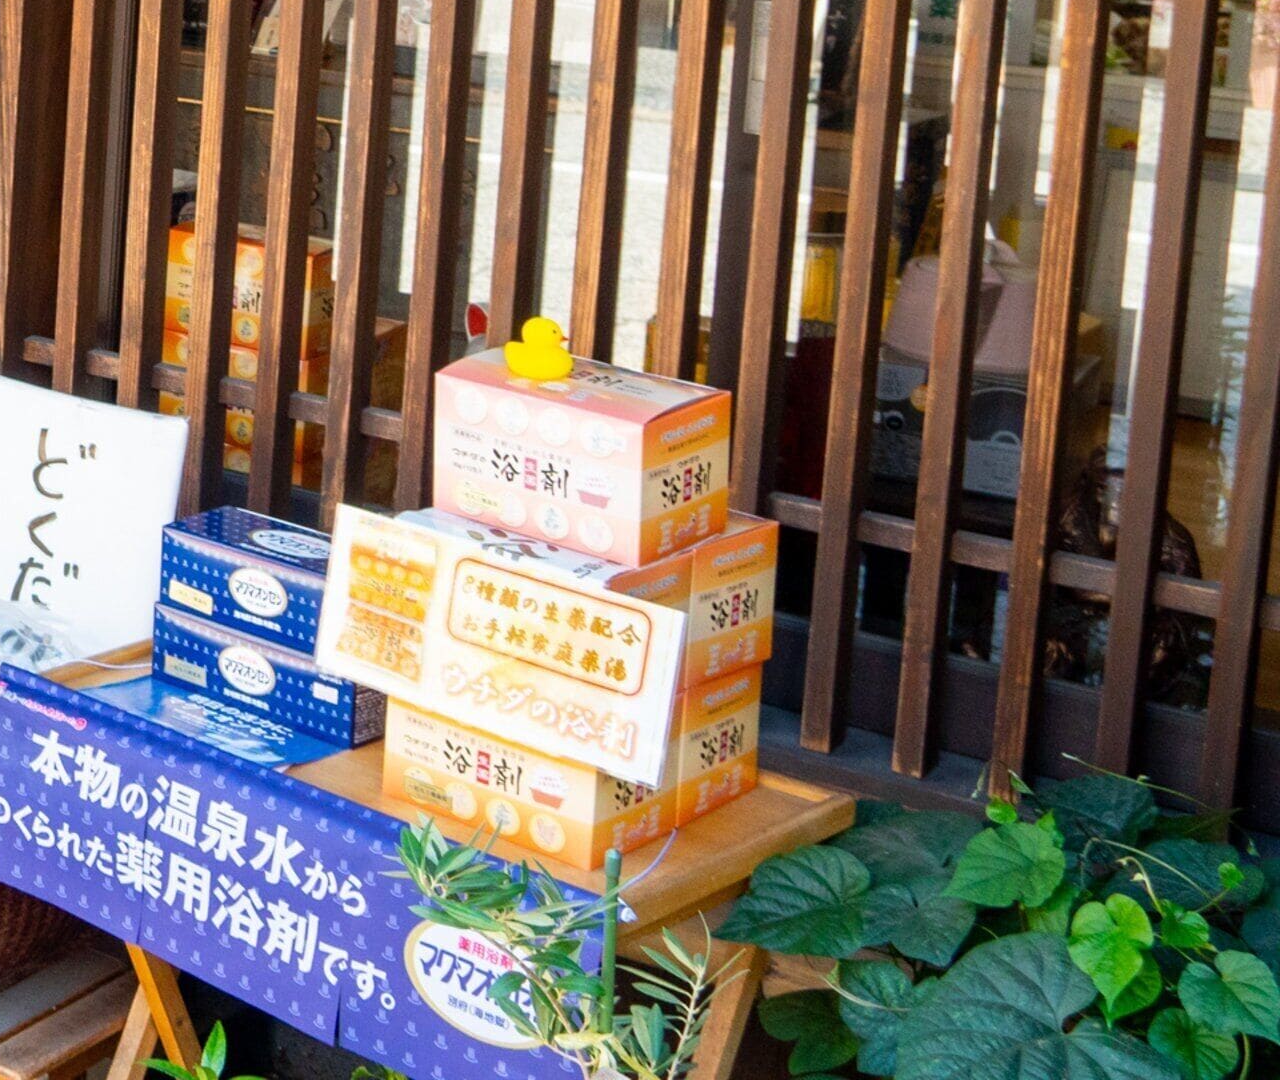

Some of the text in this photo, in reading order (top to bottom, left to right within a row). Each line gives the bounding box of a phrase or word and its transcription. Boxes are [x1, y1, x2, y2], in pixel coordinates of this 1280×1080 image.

[491, 448, 570, 500] 浴剤
[462, 614, 627, 682] お手軽家庭薬湯
[441, 663, 637, 761] ウチダの浴剤
[443, 739, 522, 796] 浴剤
[29, 730, 367, 917] 本物の温泉水から
[458, 935, 513, 971] 薬用浴剤
